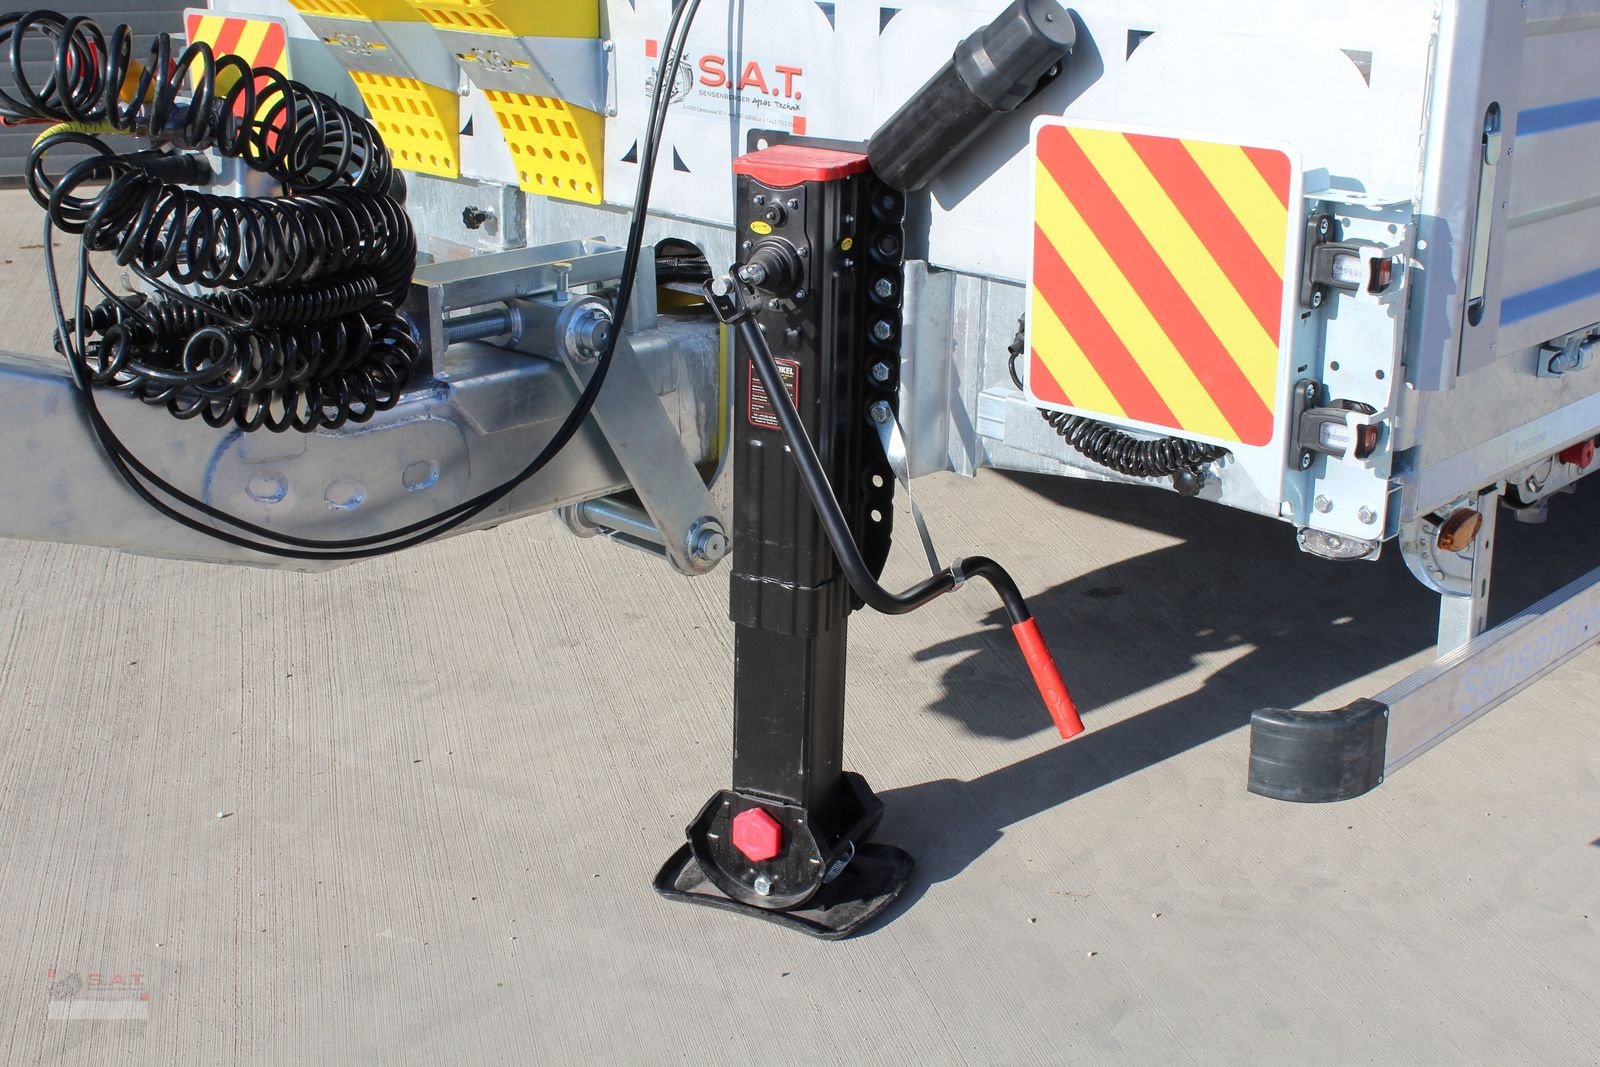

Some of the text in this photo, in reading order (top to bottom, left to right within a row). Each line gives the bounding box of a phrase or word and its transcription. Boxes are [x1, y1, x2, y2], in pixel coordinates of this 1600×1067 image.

[698, 53, 803, 100] S.A.T.
[698, 89, 752, 103] SENSENBERGER
[774, 101, 801, 111] Technik
